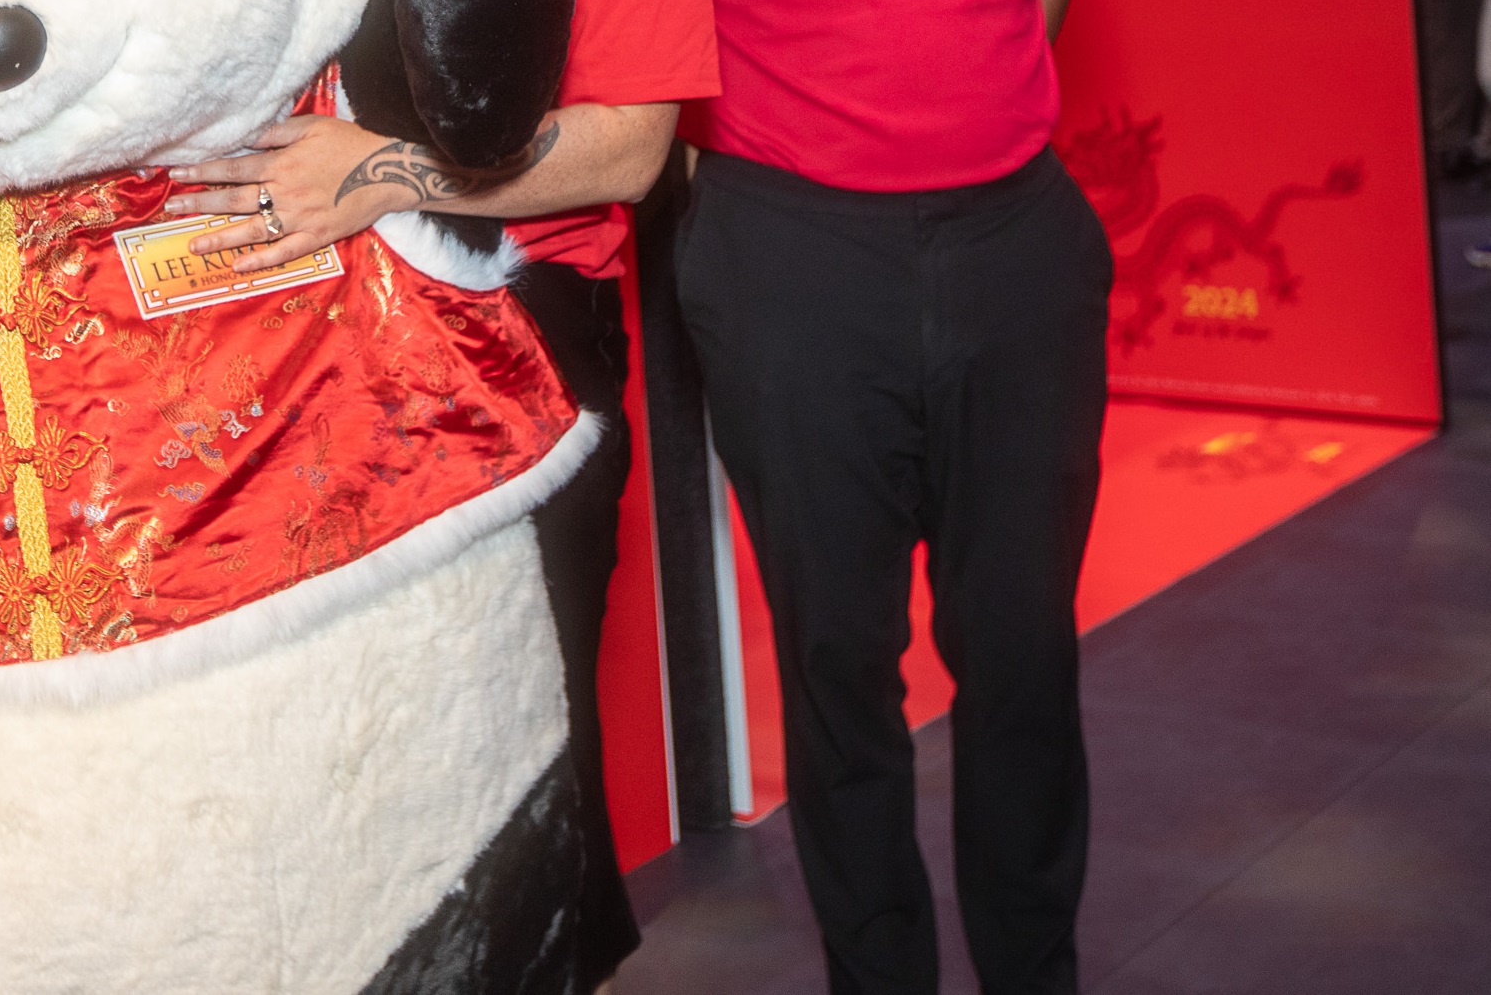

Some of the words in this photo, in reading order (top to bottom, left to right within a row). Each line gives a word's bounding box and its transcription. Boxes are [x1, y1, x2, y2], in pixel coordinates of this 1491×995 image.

[152, 255, 197, 282] LEE
[201, 271, 237, 286] HONG
[1181, 284, 1258, 320] 2024
